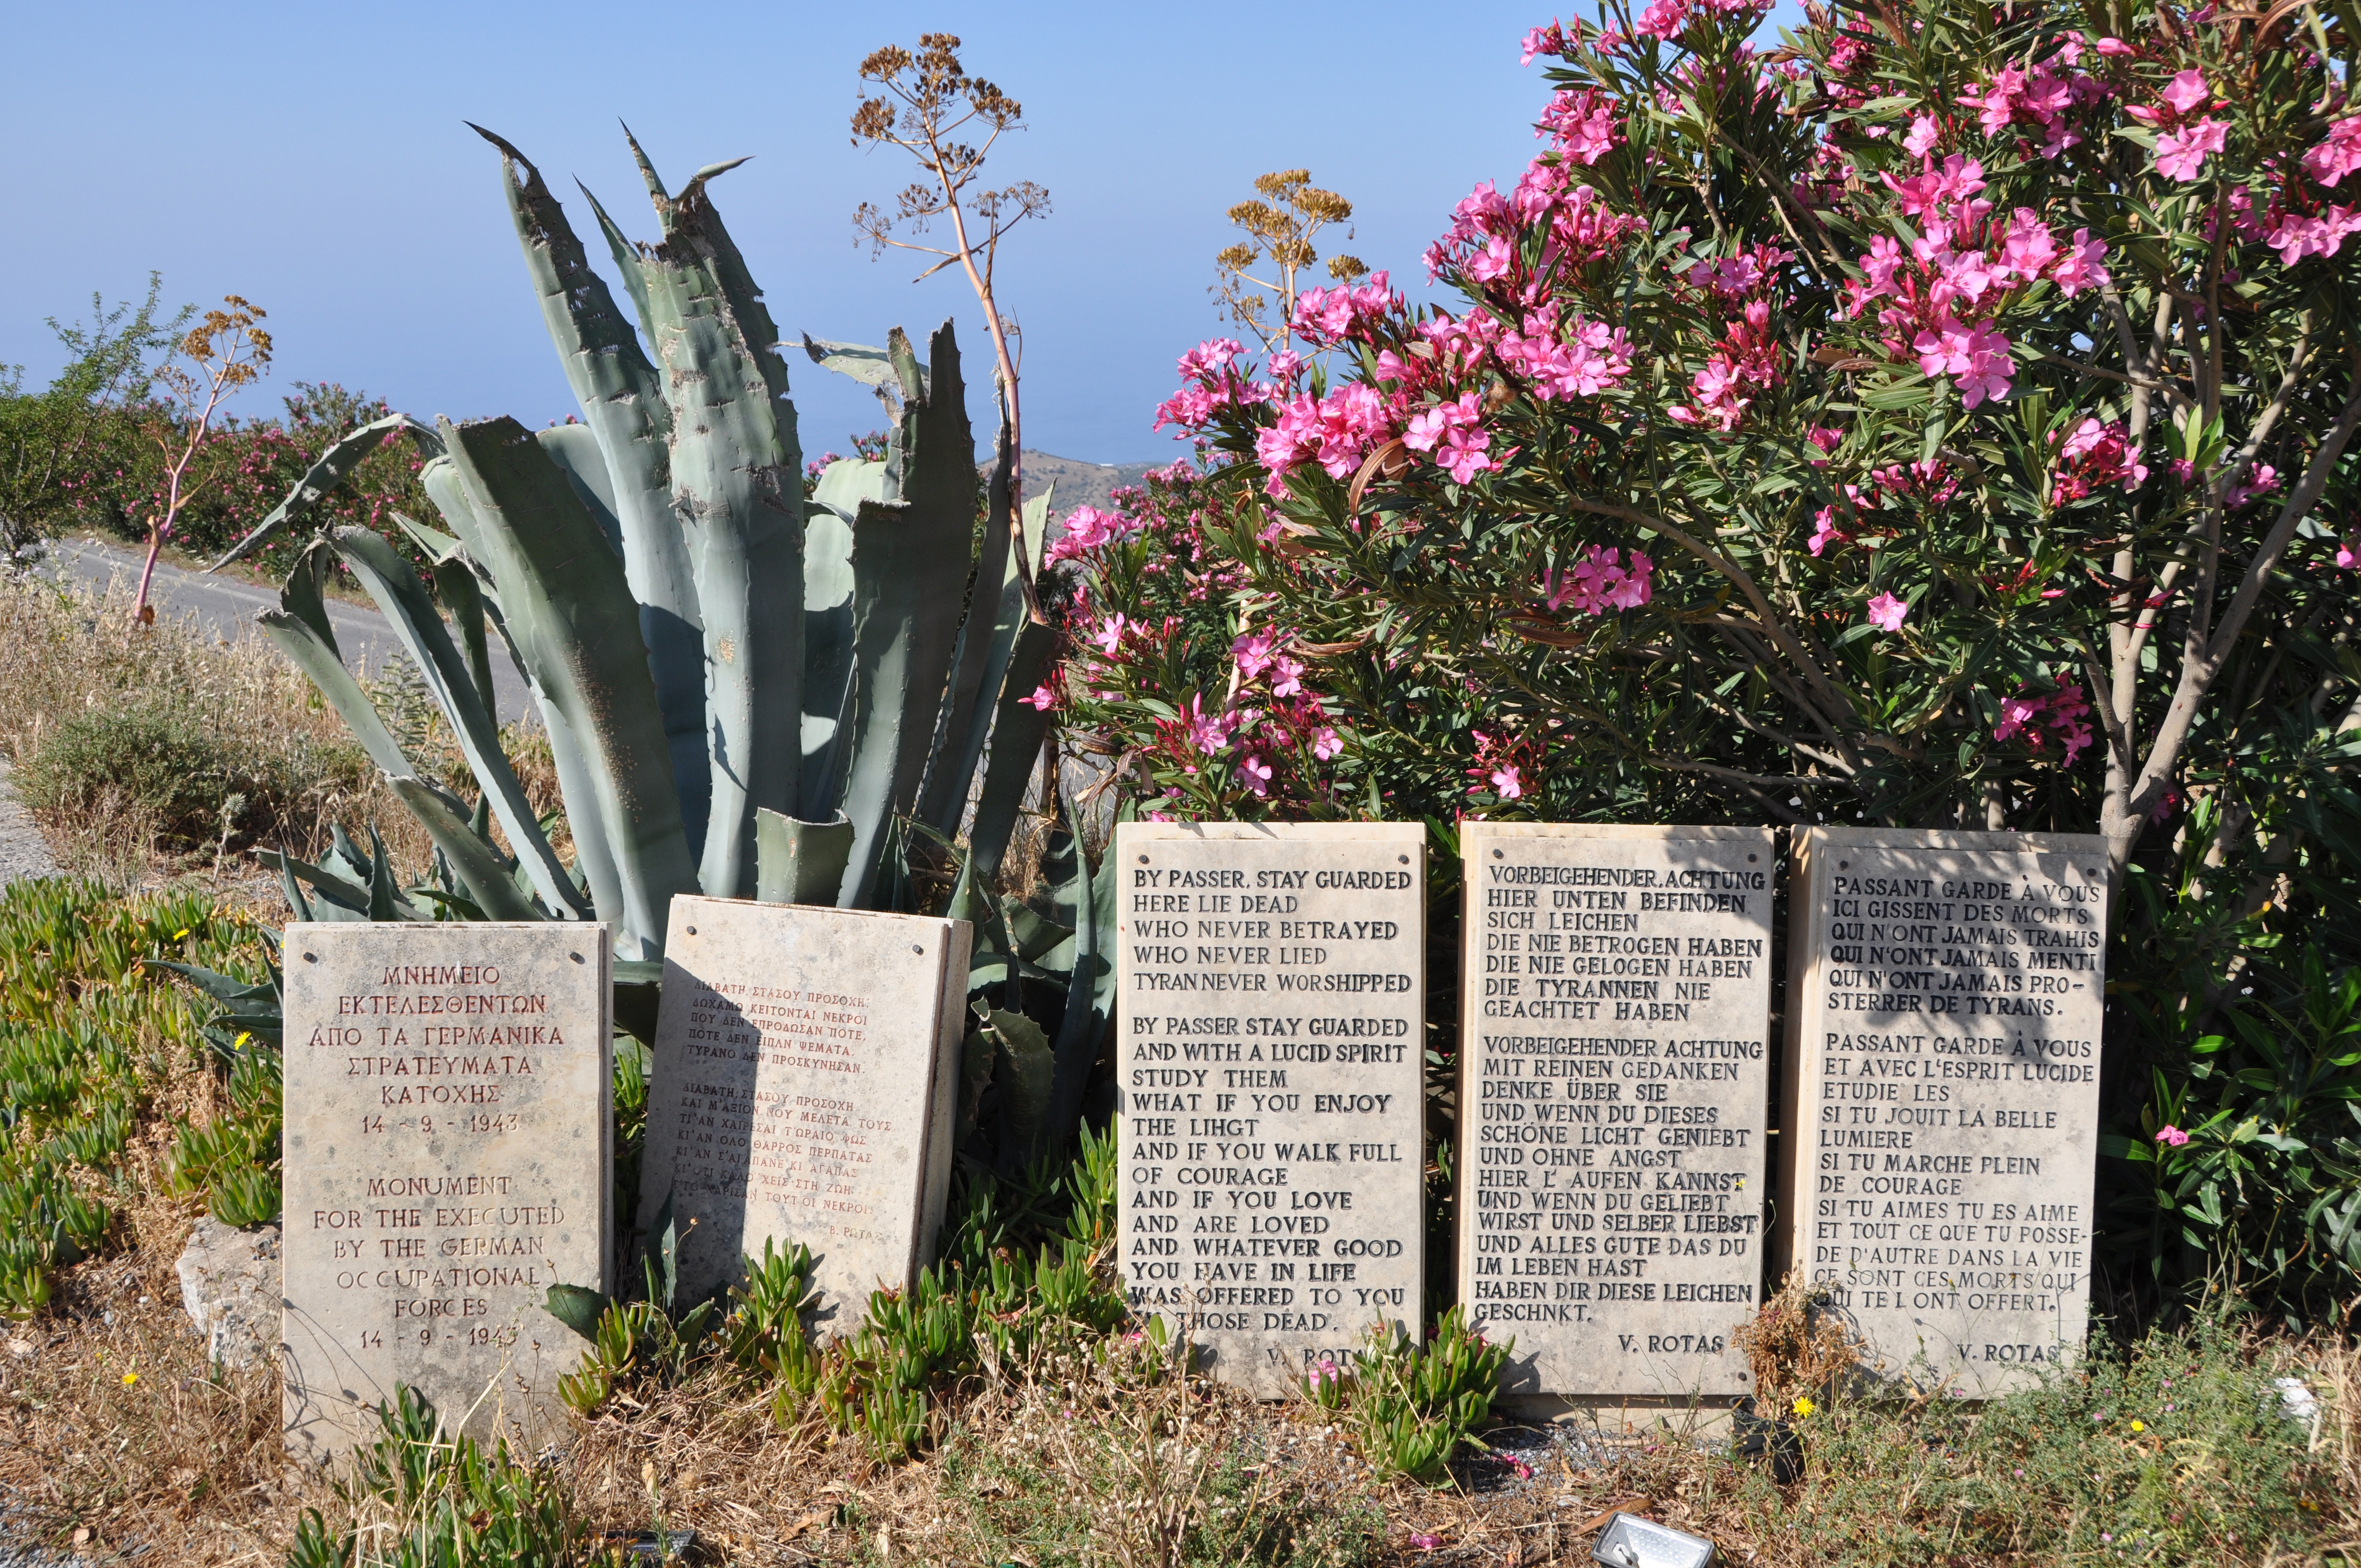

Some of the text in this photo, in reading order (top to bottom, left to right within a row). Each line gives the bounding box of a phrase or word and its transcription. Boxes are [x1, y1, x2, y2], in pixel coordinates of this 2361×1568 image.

[1135, 870, 1162, 888] BY
[1257, 870, 1309, 889] STAY
[1315, 871, 1412, 889] GUARDED
[1834, 874, 2100, 903] PASSANT GARDE À VOUS
[1134, 895, 1298, 913] HERE LIE DEAD
[1488, 889, 1746, 913] HIER UNTEN BEFINDEN
[1833, 900, 2088, 924] ICI GISSENT DES MORTS
[1135, 920, 1398, 940] WHO NEVER BETRAYED
[1487, 912, 1639, 932] SICH LEICHEN
[1135, 946, 1326, 965] WHO NEVER LIED
[1831, 946, 2096, 971] QUI N'ONT JAMAIS MENTI
[382, 966, 500, 985] ΜΝΗΜΕΙΟ
[1486, 956, 1752, 978] DIE NIE GELOGEN HABEN
[1277, 974, 1412, 992] WORSHIPPED
[1486, 979, 1710, 1000] DIE TYRANNEN NIE
[339, 994, 546, 1014] ΕΚΤΕΛΕΣΘΕΝΤΩΝ
[1484, 1000, 1690, 1022] GEACHTET HABEN
[1828, 992, 2063, 1016] STERRER DE TYRANS.
[691, 1013, 716, 1023] ΠΟΥ
[309, 1027, 564, 1046] ΑΠΟ ΤΑ ΓΕΡΜΑΝΙΚΑ
[689, 1029, 720, 1041] ΠΟΤΕ
[1484, 1037, 1764, 1060] VORBEIGEHENDER ACHTUNG
[348, 1056, 533, 1075] ΣΤΡΑΤΕΥΜΑΤΑ
[1484, 1059, 1739, 1081] MIT REINEN GEDANKEN
[1825, 1058, 2094, 1082] ET AVEC L'ESPRIT LUCIDE
[1132, 1069, 1288, 1088] STUDY THEM
[381, 1086, 500, 1104] ΚΑΤΟΧΗΣ
[1481, 1078, 1668, 1102] DENKE ÜBER SIE
[1823, 1082, 1950, 1101] ETUDIE LES
[1132, 1094, 1392, 1113] WHAT IF YOU ENJOY
[471, 1114, 518, 1132] 1943
[1132, 1119, 1259, 1137] THE LIHGT
[1481, 1121, 1568, 1144] SCHÖNE
[1582, 1127, 1644, 1146] LICHT
[1820, 1130, 1912, 1148] LUMIERE
[1821, 1154, 2040, 1175] SI TU MARCHE PLEIN
[1132, 1167, 1288, 1185] OF COURAGE
[1820, 1176, 1962, 1195] DE COURAGE
[367, 1177, 513, 1196] MONUMENT
[1132, 1190, 1352, 1209] AND IF YOU LOVE
[314, 1207, 564, 1229] FOR THE EXECUTED
[335, 1237, 544, 1258] BY THE GERMAN
[1132, 1238, 1403, 1257] AND WHATEVER GOOD
[1476, 1257, 1647, 1277] IM LEBEN HAST
[337, 1267, 540, 1289] OCCUPATIONAL
[395, 1299, 488, 1317] FORCES
[470, 1327, 516, 1346] 1943
[1619, 1335, 1724, 1353] V. ROTAS
[1956, 1344, 2059, 1362] V. ROTAS
